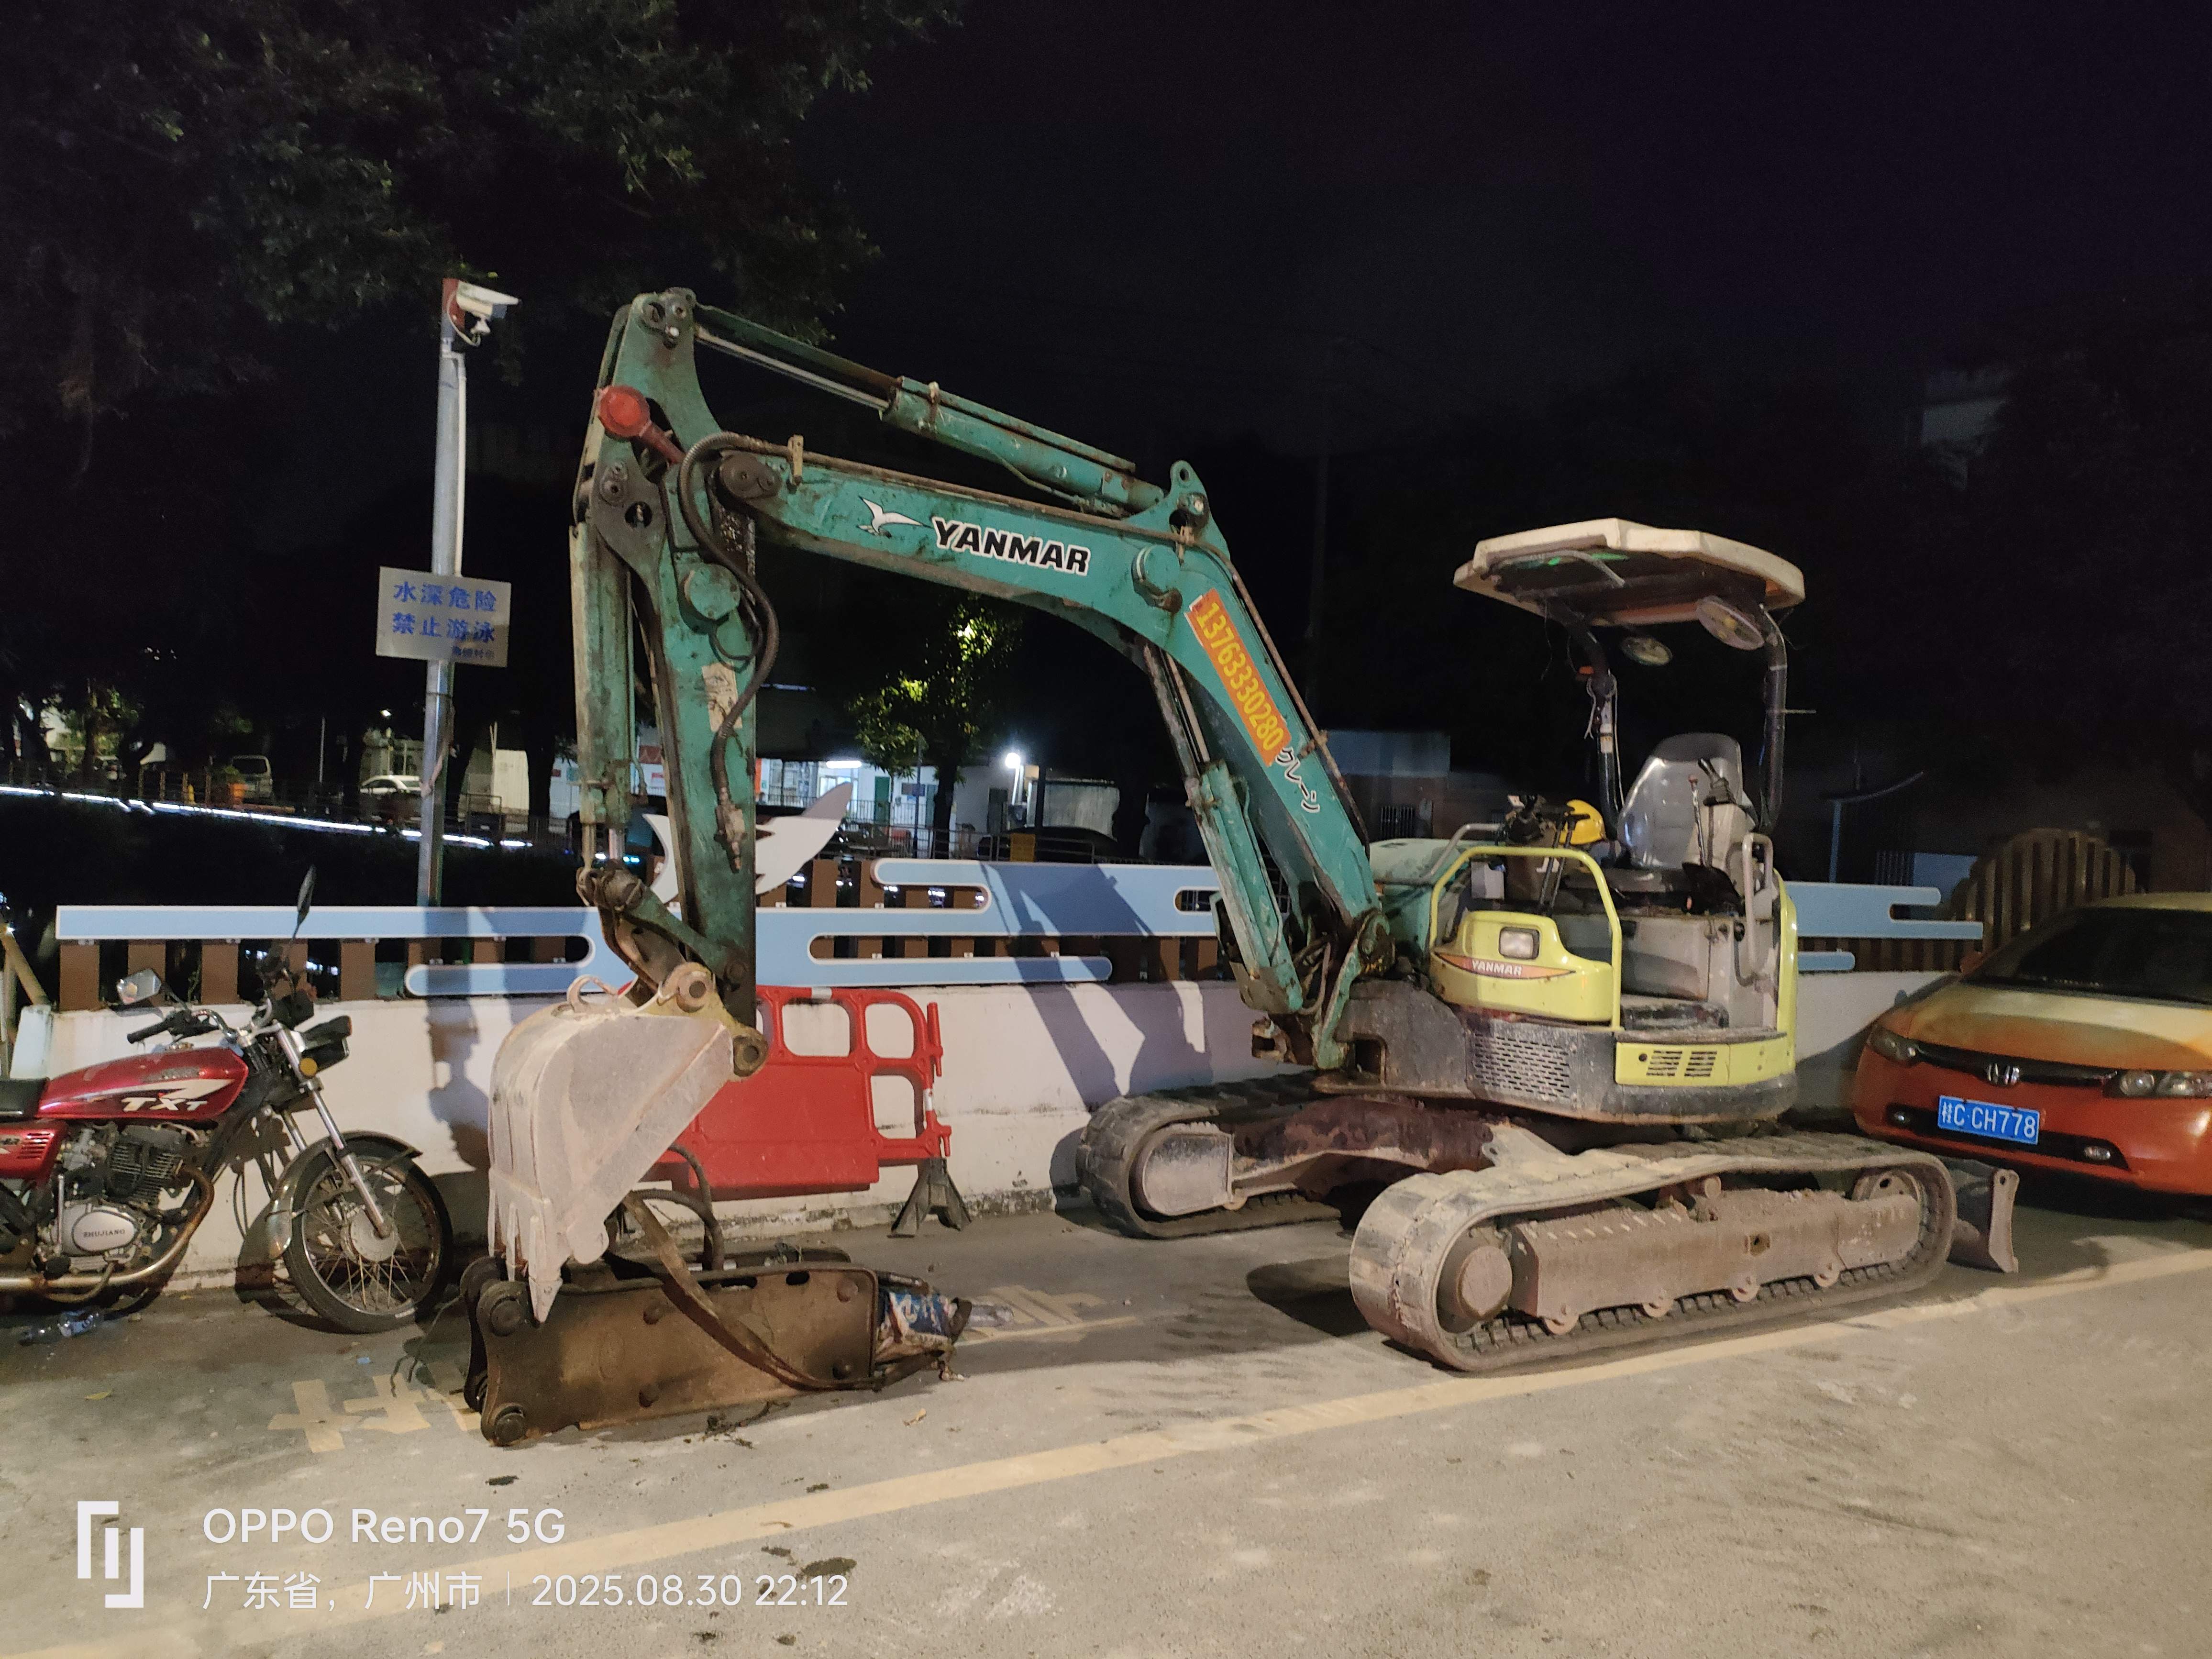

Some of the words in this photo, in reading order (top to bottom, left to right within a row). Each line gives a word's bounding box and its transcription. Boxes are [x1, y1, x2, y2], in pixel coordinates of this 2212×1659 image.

[932, 516, 1091, 576] YANMAR
[394, 581, 497, 612] 水深危险
[392, 611, 495, 642] 禁止游泳
[1196, 602, 1285, 751] 13763330280
[1471, 959, 1523, 976] YANMAR
